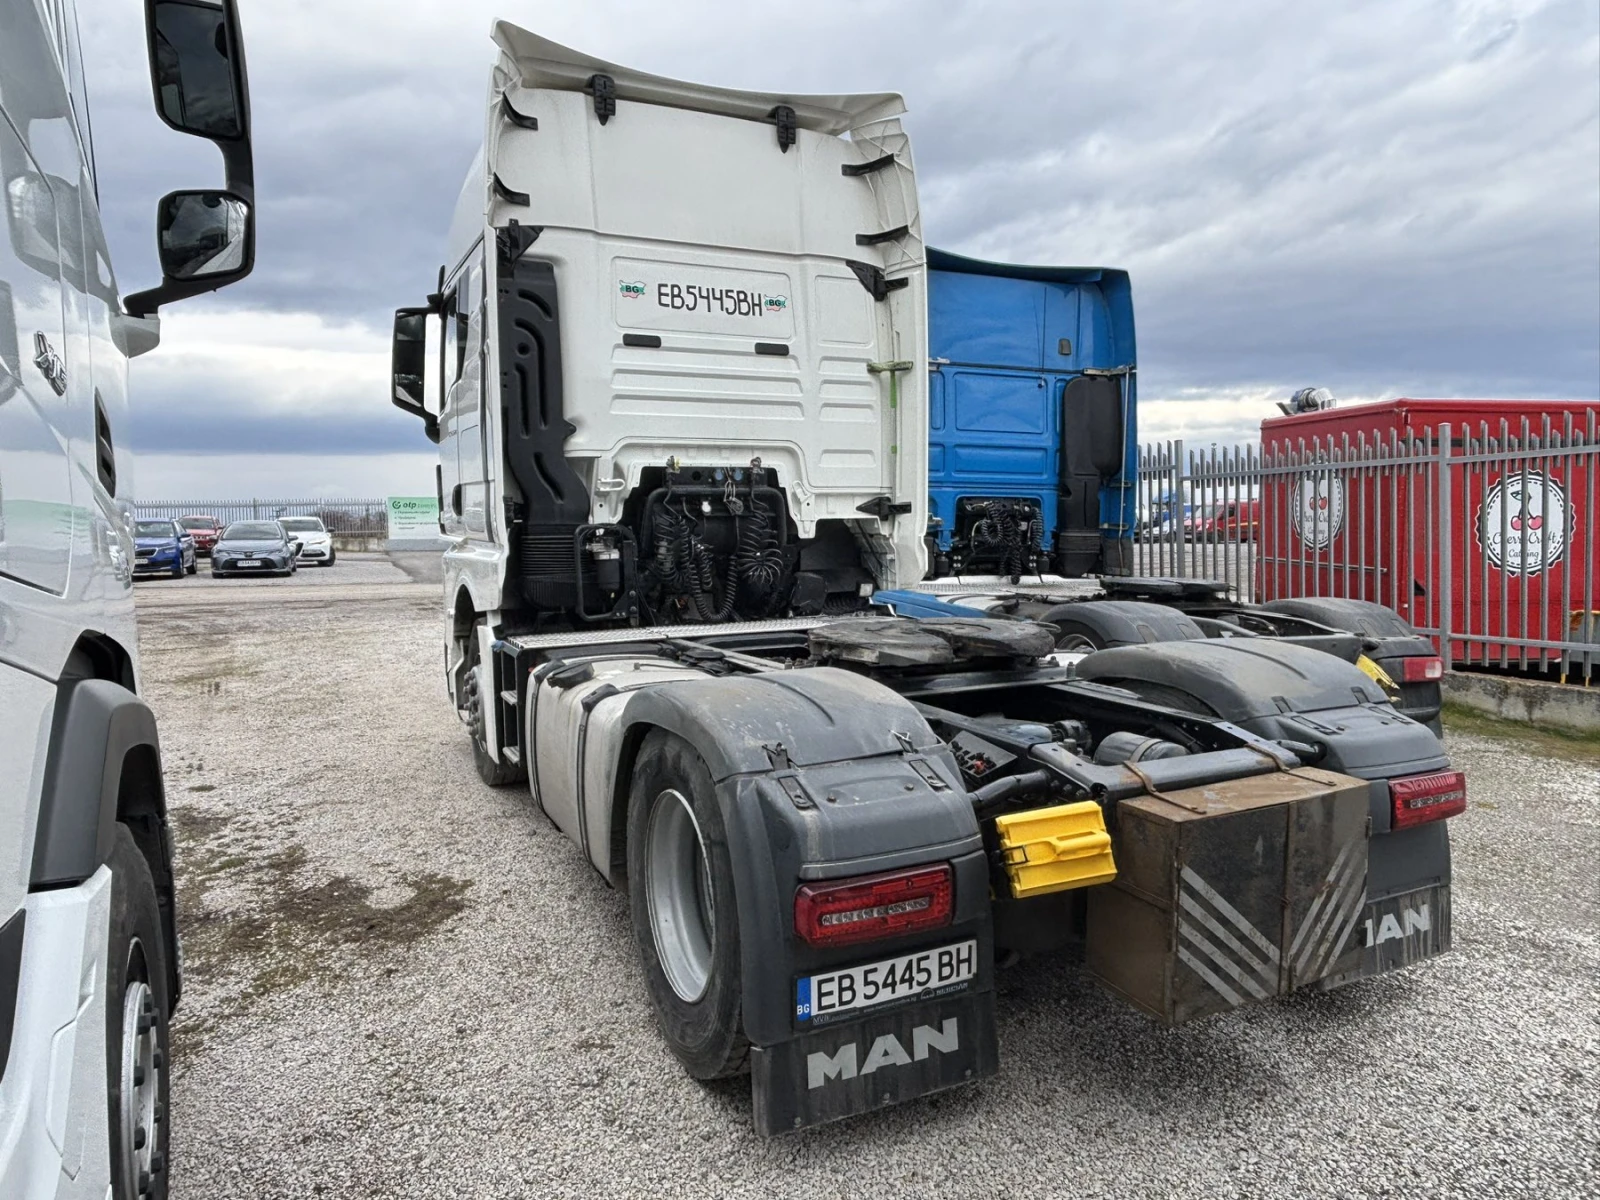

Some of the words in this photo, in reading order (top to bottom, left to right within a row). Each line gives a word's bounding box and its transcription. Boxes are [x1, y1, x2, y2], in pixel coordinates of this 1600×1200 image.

[625, 284, 640, 294] BG
[657, 283, 763, 317] EB5445BH
[768, 298, 782, 307] BG
[1528, 531, 1557, 545] Crft
[1508, 549, 1540, 561] Cating
[816, 973, 857, 1012] EB
[862, 954, 932, 1001] 5445
[937, 944, 973, 983] BH
[796, 1003, 810, 1015] BG
[807, 1016, 959, 1090] MAN
